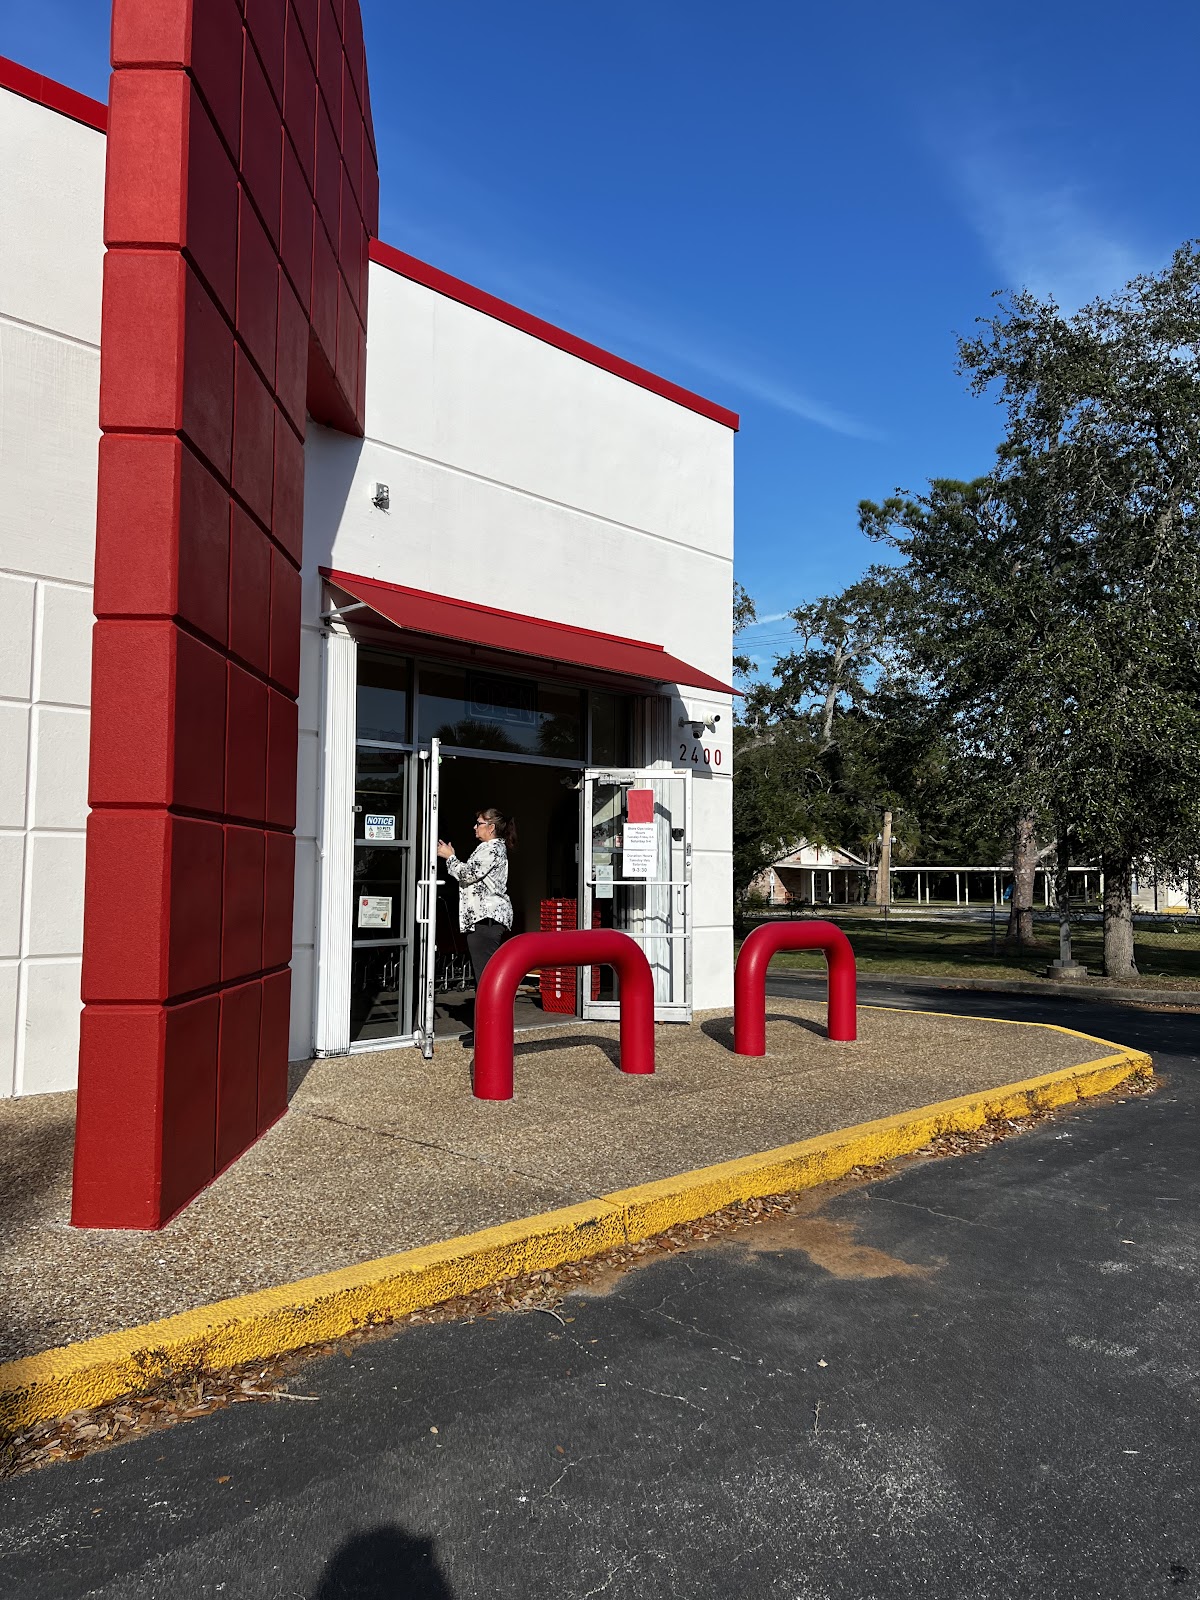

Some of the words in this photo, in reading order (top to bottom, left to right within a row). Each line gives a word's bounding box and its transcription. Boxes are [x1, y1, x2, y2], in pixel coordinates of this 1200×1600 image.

[473, 682, 532, 719] OPEN
[679, 743, 722, 766] 2400
[367, 816, 393, 825] NOTICE
